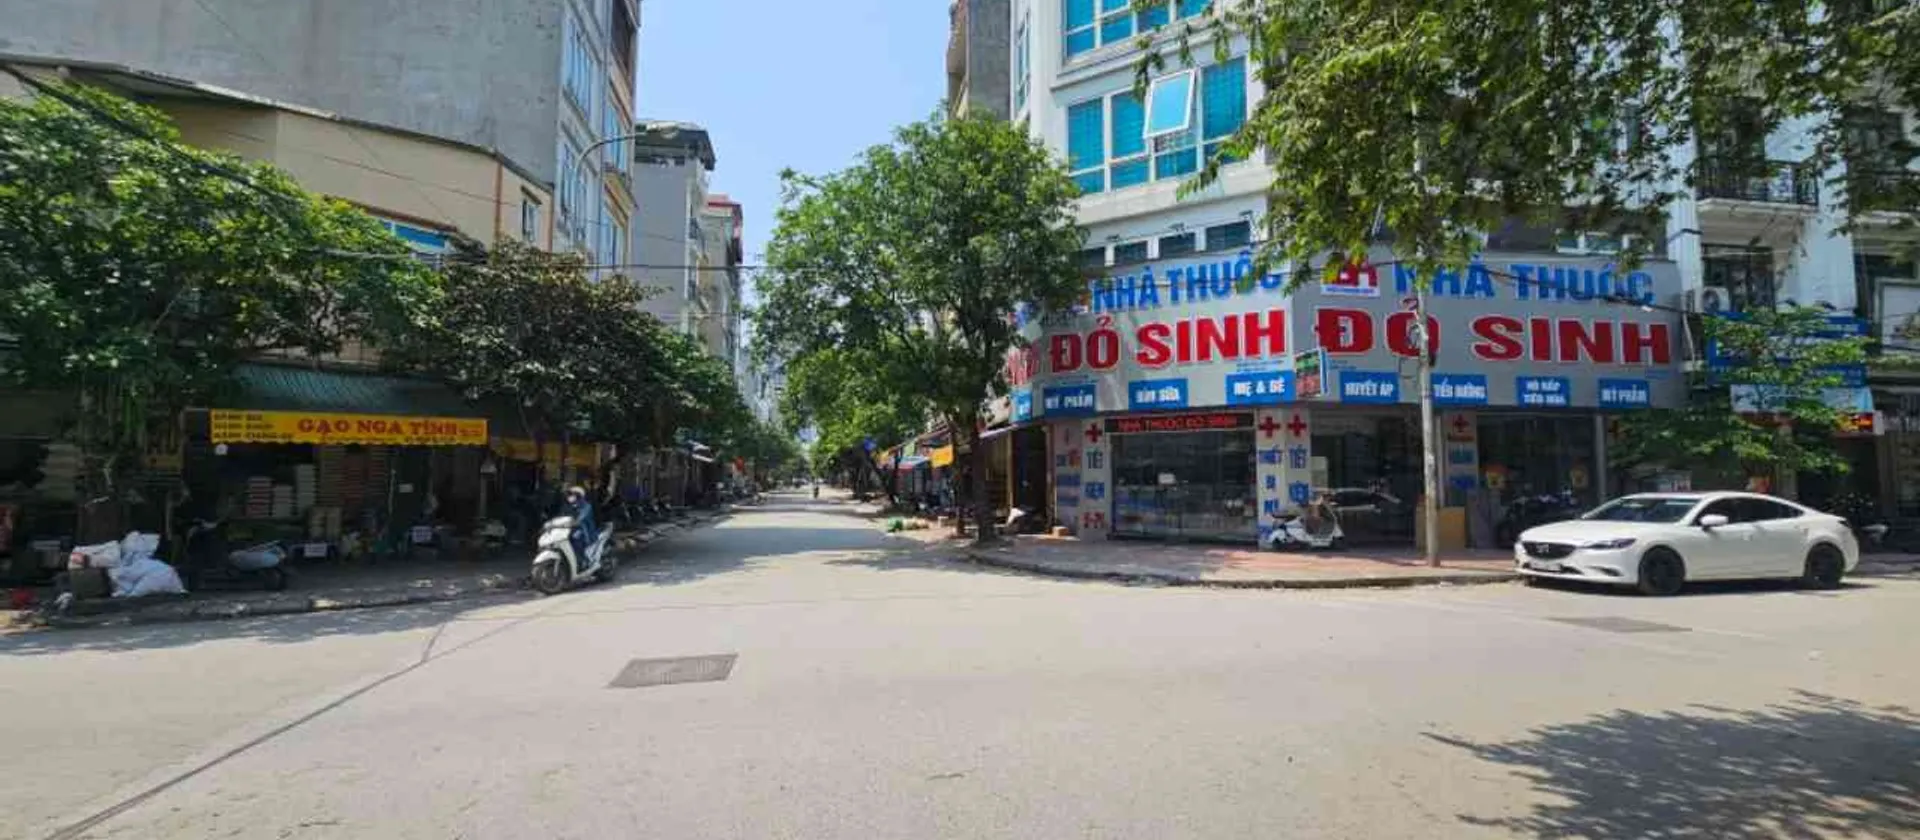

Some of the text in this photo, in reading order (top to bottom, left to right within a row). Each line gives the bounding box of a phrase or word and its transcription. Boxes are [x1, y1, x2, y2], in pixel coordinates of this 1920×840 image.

[1091, 264, 1159, 313] NHÀ
[1049, 315, 1120, 374] ĐỎ
[1135, 308, 1286, 368] SINH
[1313, 297, 1671, 365] ĐỎ SINH
